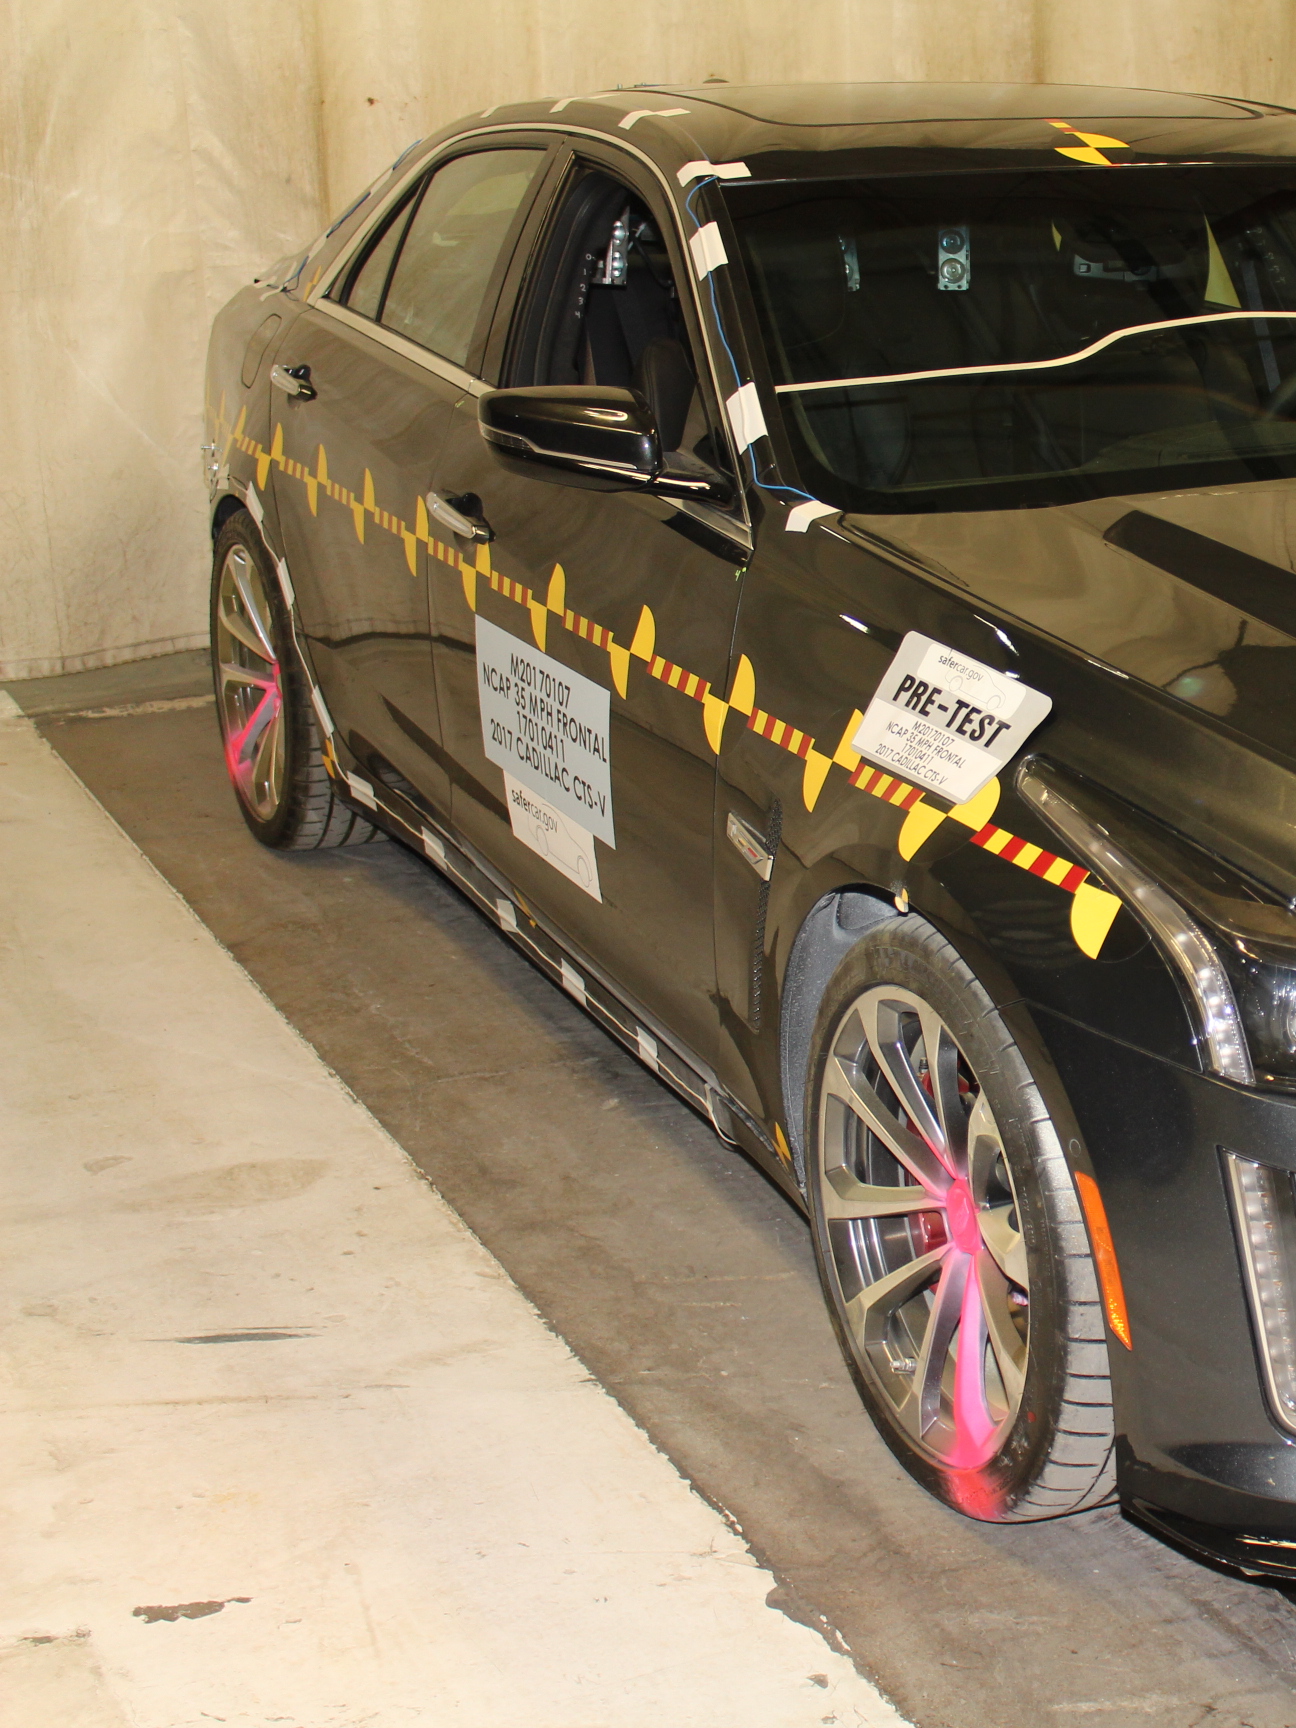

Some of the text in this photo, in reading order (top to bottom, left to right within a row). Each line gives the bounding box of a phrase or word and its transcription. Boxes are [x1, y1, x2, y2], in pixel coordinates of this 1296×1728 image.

[511, 652, 571, 710] M20170107
[938, 653, 984, 683] safercar.gov
[482, 661, 608, 764] NCAP 35 MPH FRONTAL
[892, 674, 1011, 748] PRE-TEST
[912, 720, 956, 747] M20170107
[516, 710, 565, 763] 17010411
[886, 720, 967, 769] NCAP 35 MPH FRONTAL
[900, 743, 934, 765] 17010411
[490, 718, 606, 818] 2017 CADILLAC CTS-V
[874, 743, 949, 786] 2017 CADILLAC CTS-V
[511, 788, 559, 834] safercar.gov
